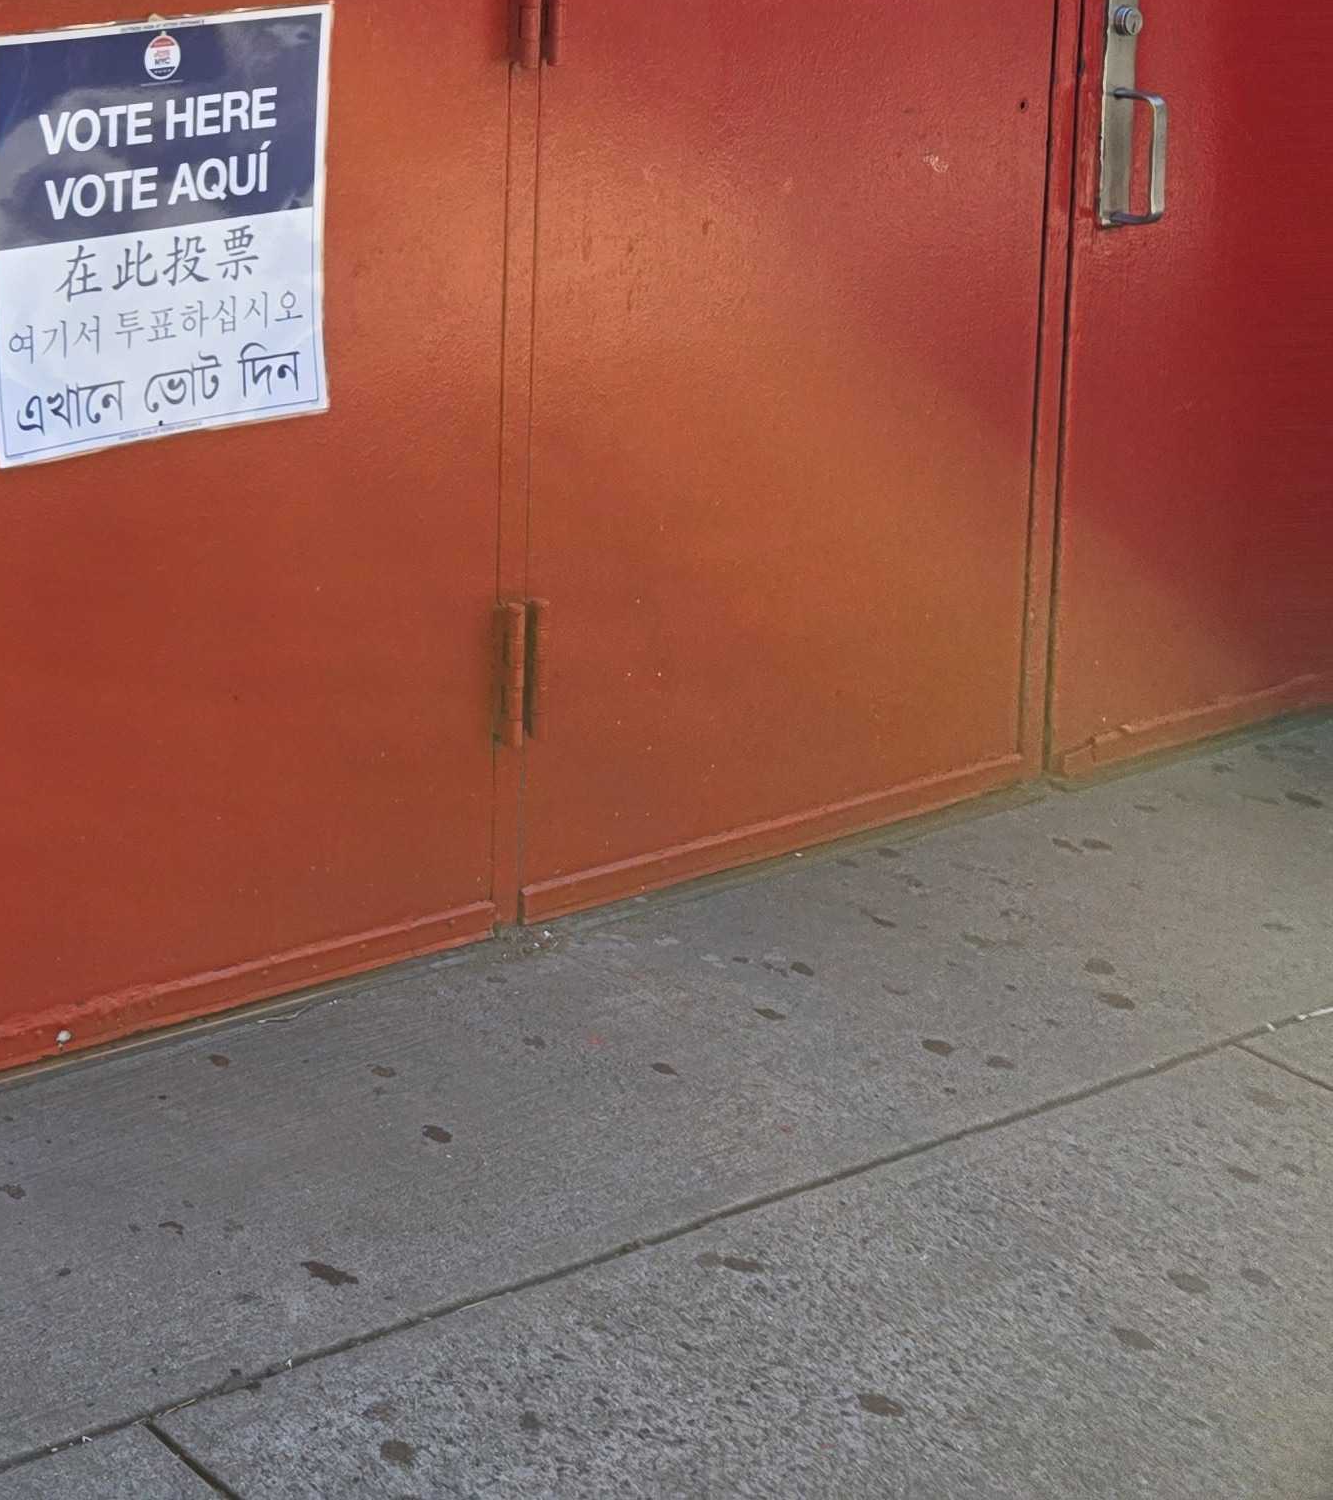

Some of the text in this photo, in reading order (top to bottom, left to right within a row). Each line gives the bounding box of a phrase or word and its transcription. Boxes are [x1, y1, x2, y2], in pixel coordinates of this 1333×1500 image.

[39, 87, 278, 155] VOTE HERE
[45, 140, 269, 220] VOTE AQUÍ
[55, 224, 260, 302] 在此投票
[9, 289, 304, 364] 여기서 투표하십시오
[17, 342, 300, 435] এখানে ভোট দিন
